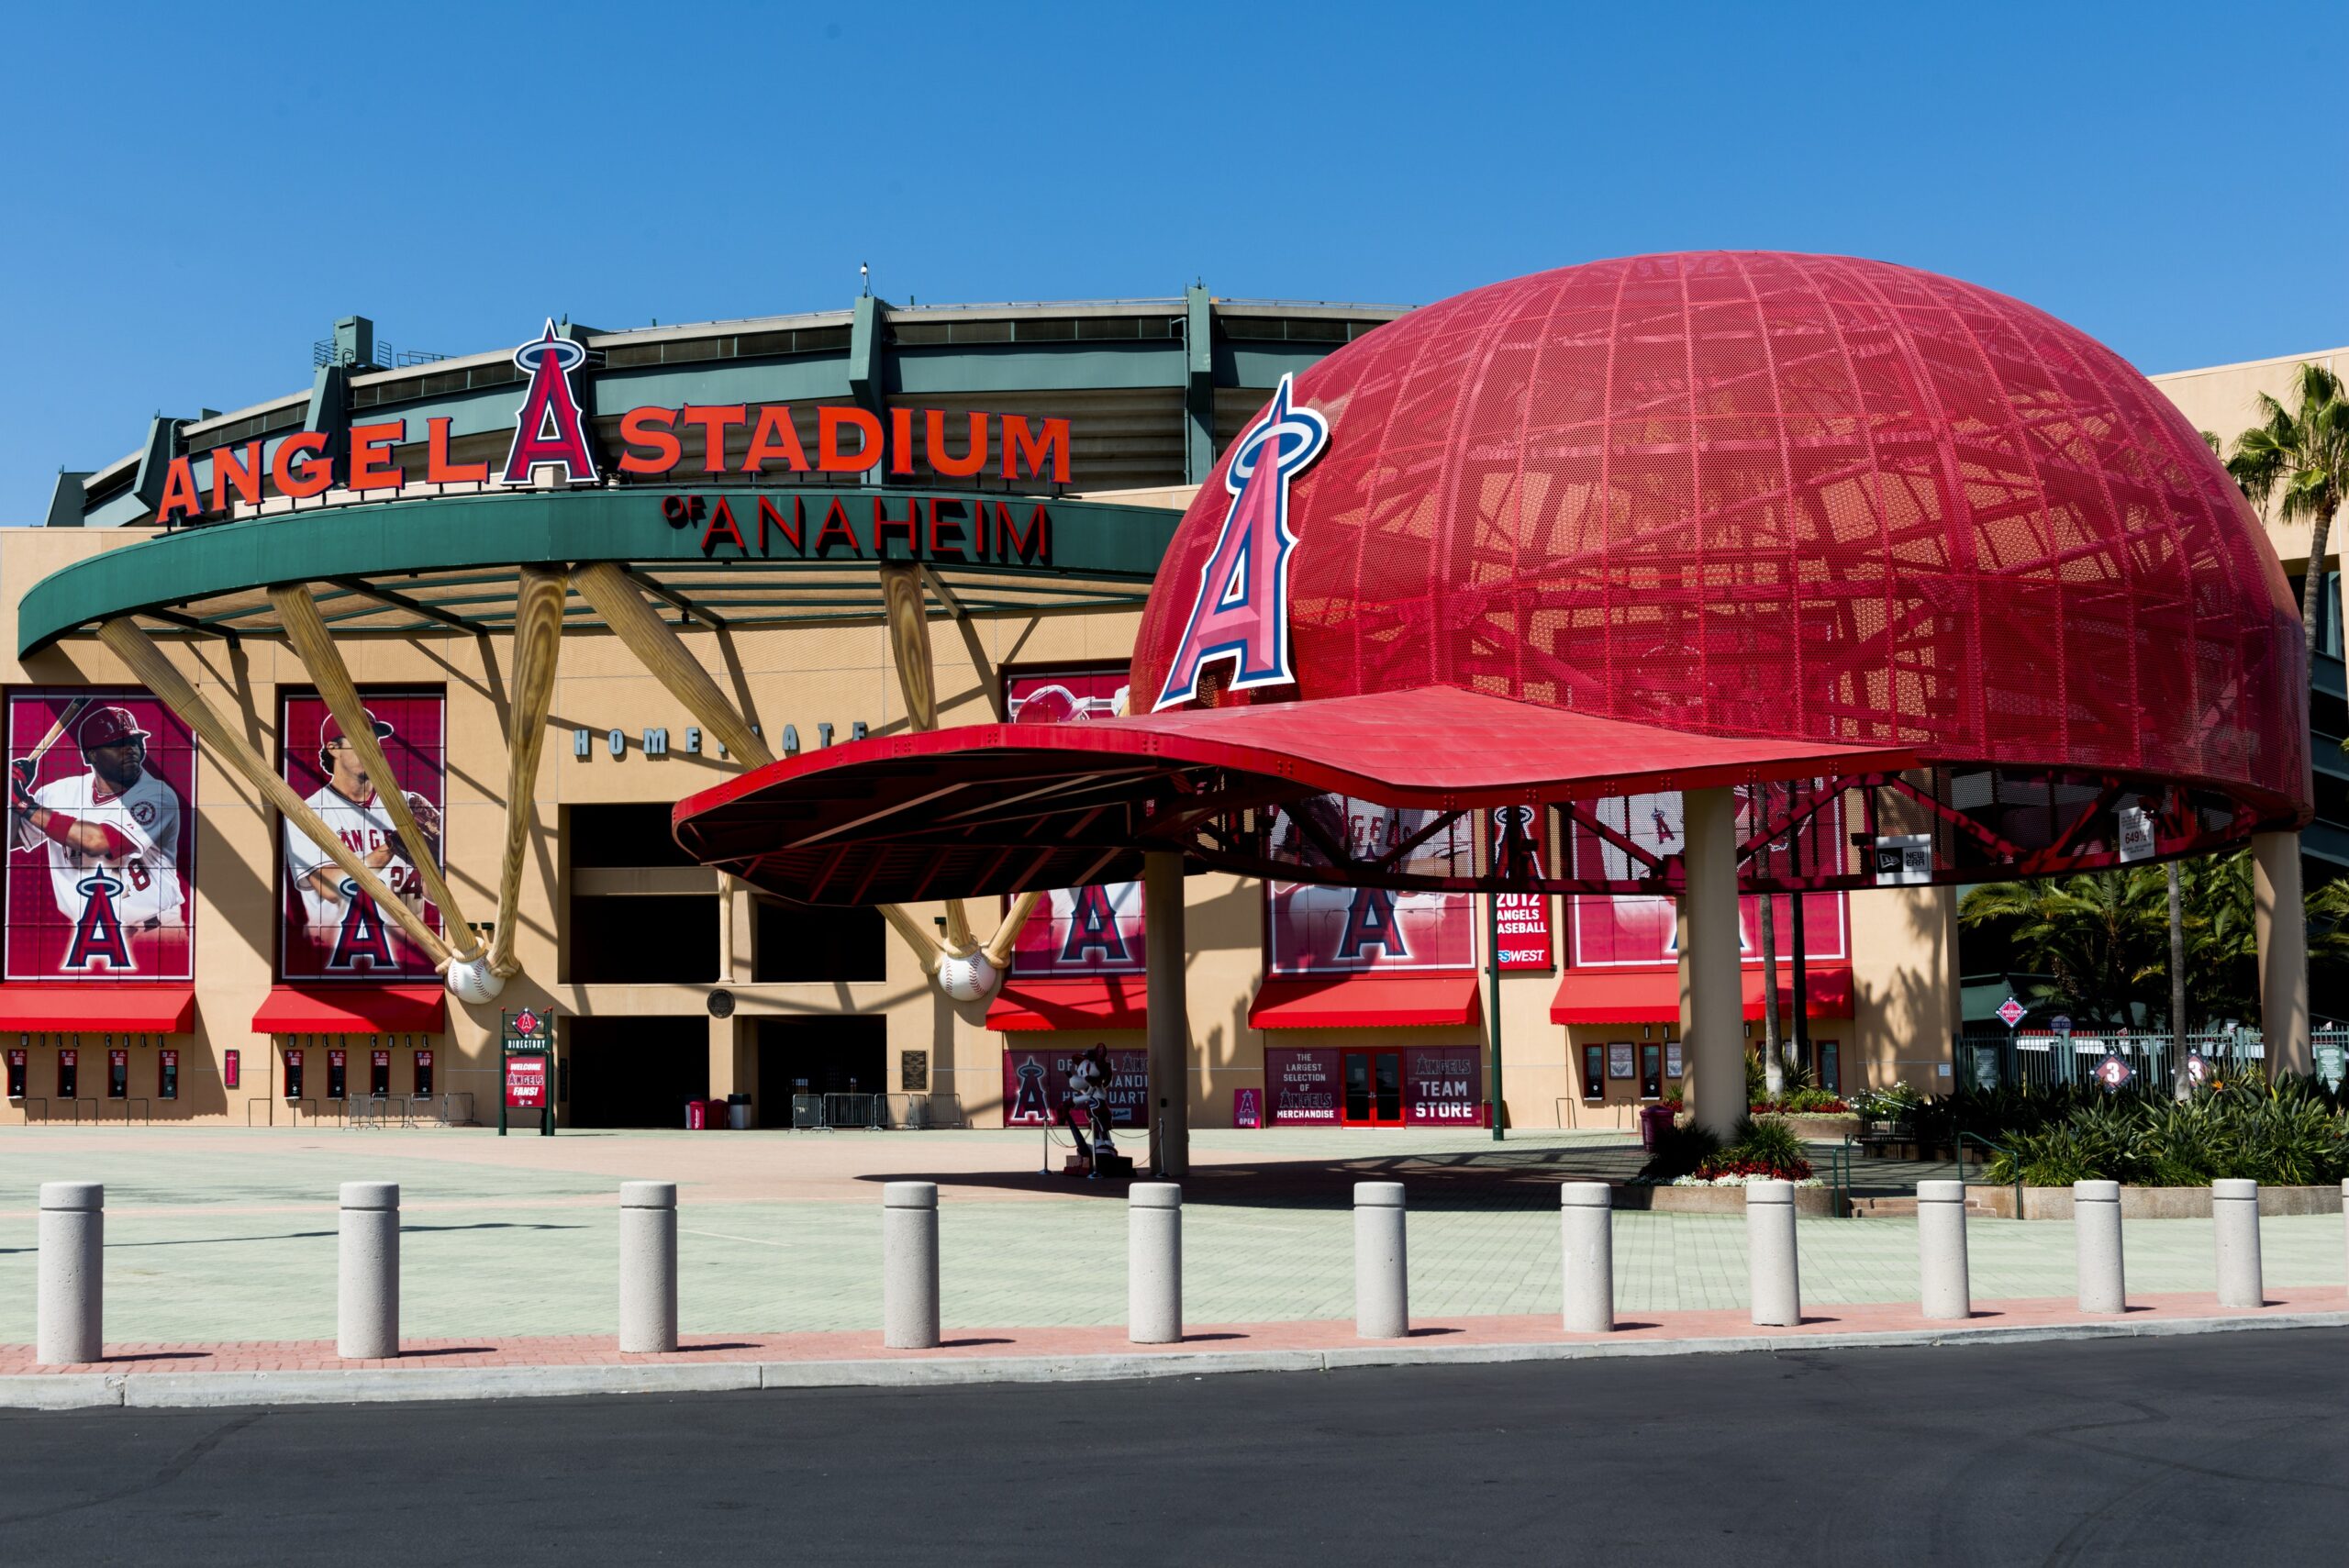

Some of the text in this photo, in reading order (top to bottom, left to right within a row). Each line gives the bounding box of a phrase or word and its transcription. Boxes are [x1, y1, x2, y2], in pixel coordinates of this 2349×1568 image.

[155, 402, 1073, 524] ANGEL STADIUM
[661, 495, 1047, 557] OF ANAHEIM
[1151, 372, 1329, 713] A
[573, 727, 700, 756] HOME
[1906, 859, 1925, 867] ERA
[1497, 909, 1540, 921] ANGELS
[1497, 922, 1547, 934] ASEBALL
[21, 1034, 164, 1047] WILL CALL
[288, 1035, 429, 1047] WILL CALL
[507, 1040, 546, 1049] DIRECTORY
[418, 1058, 431, 1066] VIP
[1297, 1053, 1312, 1062] THE
[1283, 1073, 1326, 1082] SELECTION
[2106, 1062, 2120, 1083] 3
[2188, 1061, 2202, 1082] 3
[507, 1071, 544, 1085] ANGELS
[513, 1087, 539, 1096] FANS!
[1299, 1084, 1310, 1092] OF
[1419, 1081, 1467, 1096] TEAM
[1278, 1087, 1332, 1108] ANGELS
[1276, 1109, 1334, 1118] MERCHANDISE
[1415, 1102, 1473, 1118] STORE
